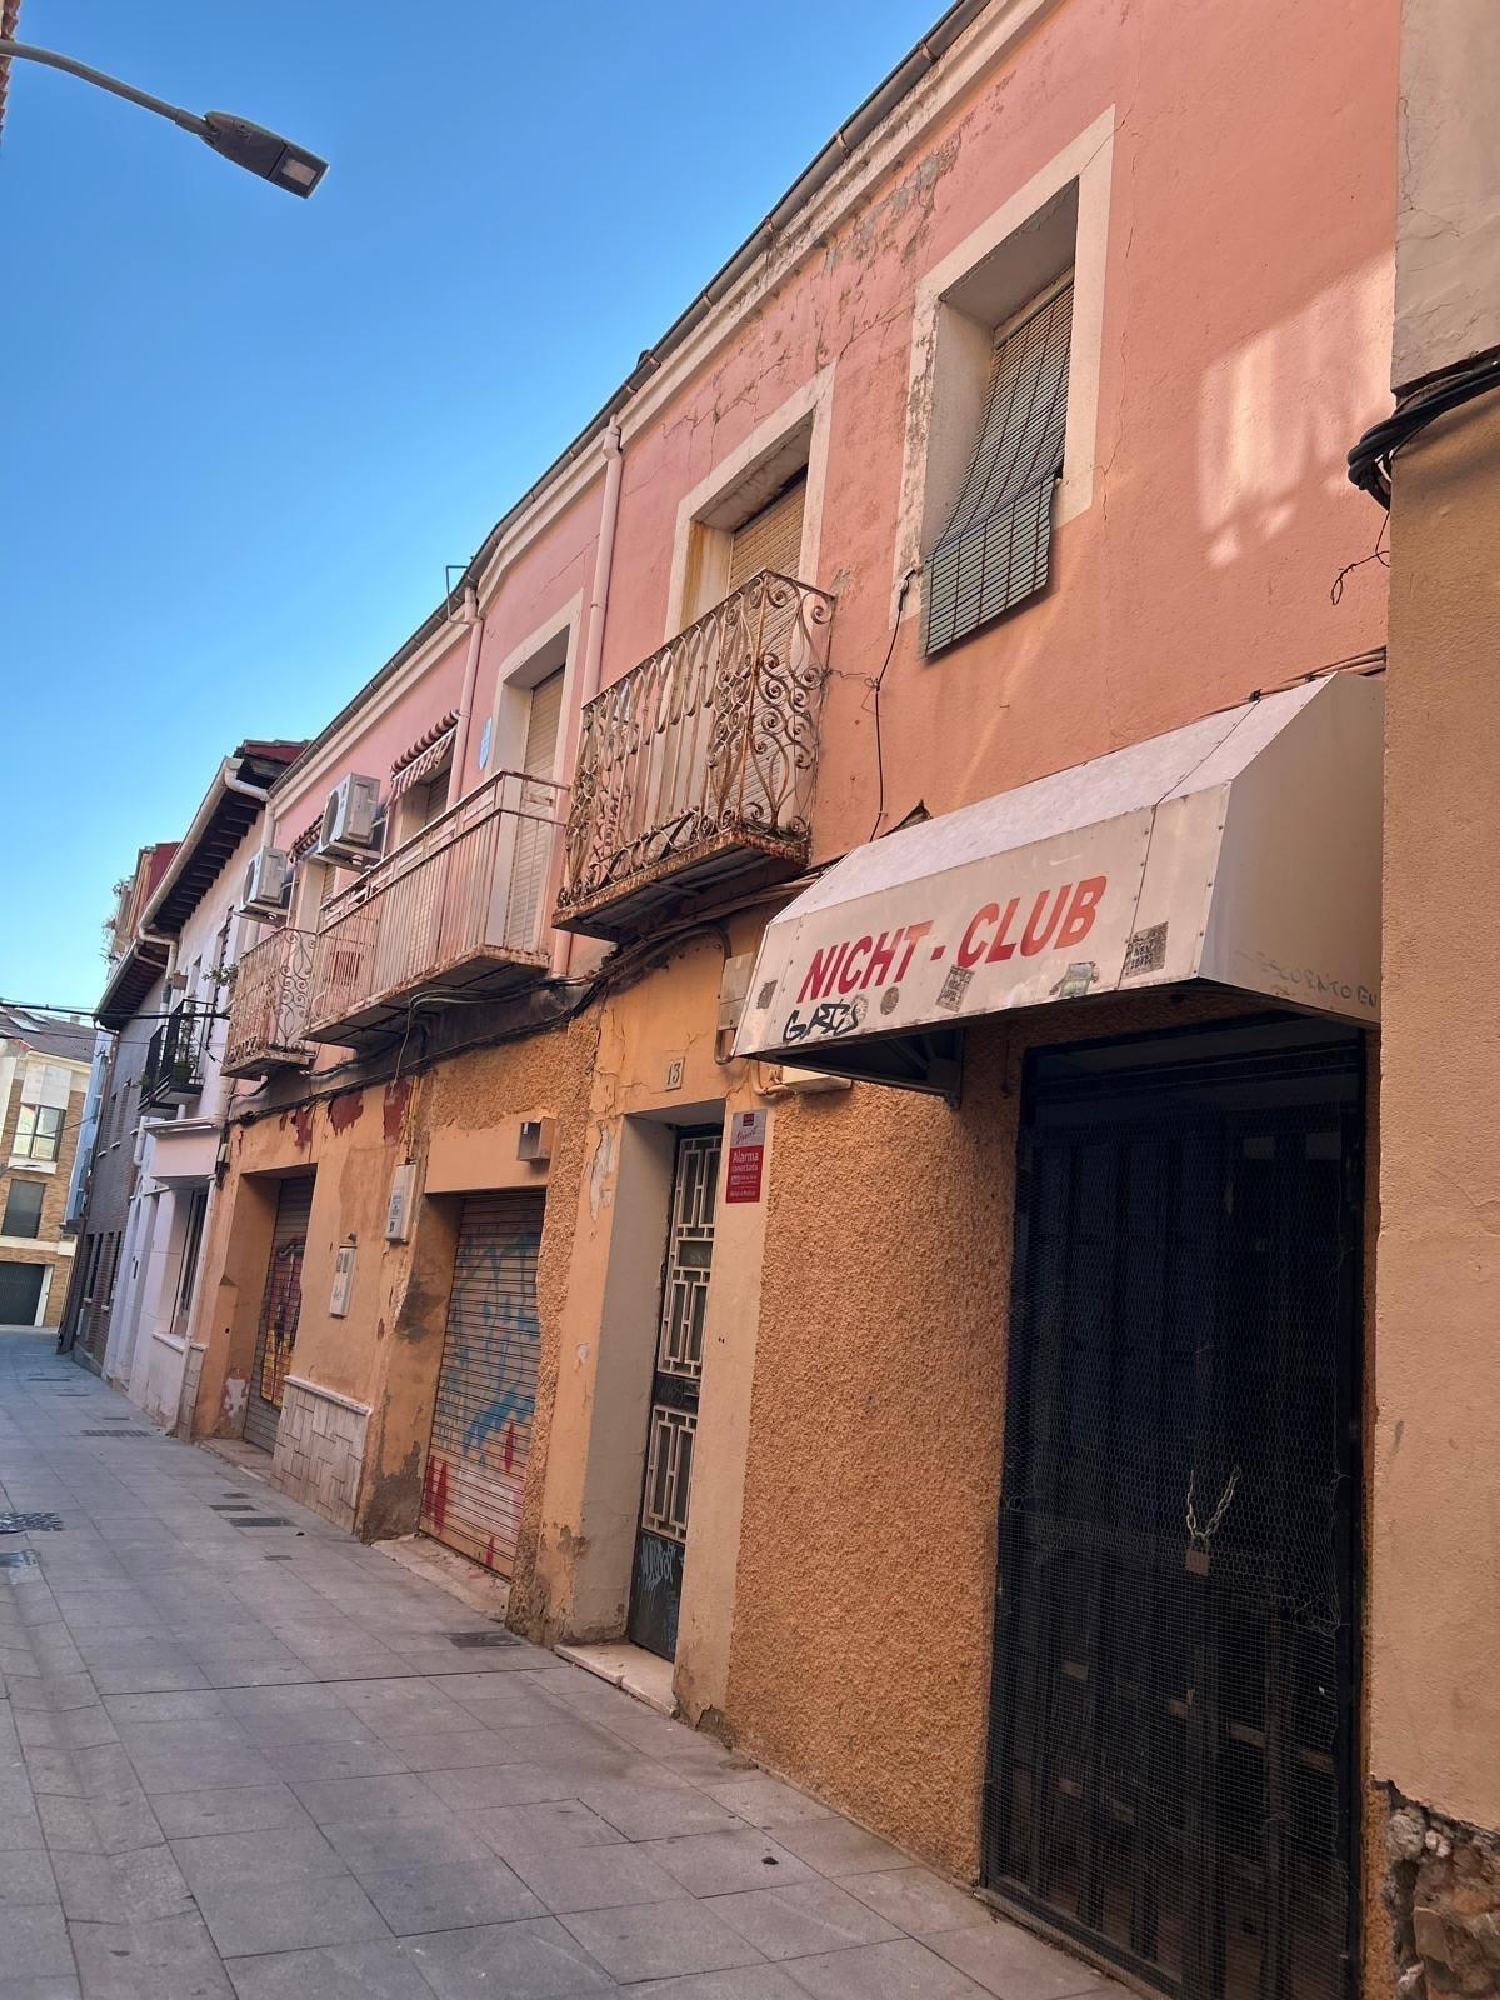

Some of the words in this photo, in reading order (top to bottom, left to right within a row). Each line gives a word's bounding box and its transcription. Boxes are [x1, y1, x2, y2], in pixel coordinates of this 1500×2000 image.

[796, 920, 933, 1004] NICHT
[958, 875, 1107, 968] CLUB
[667, 1062, 681, 1085] 13
[733, 1150, 759, 1163] Alarma
